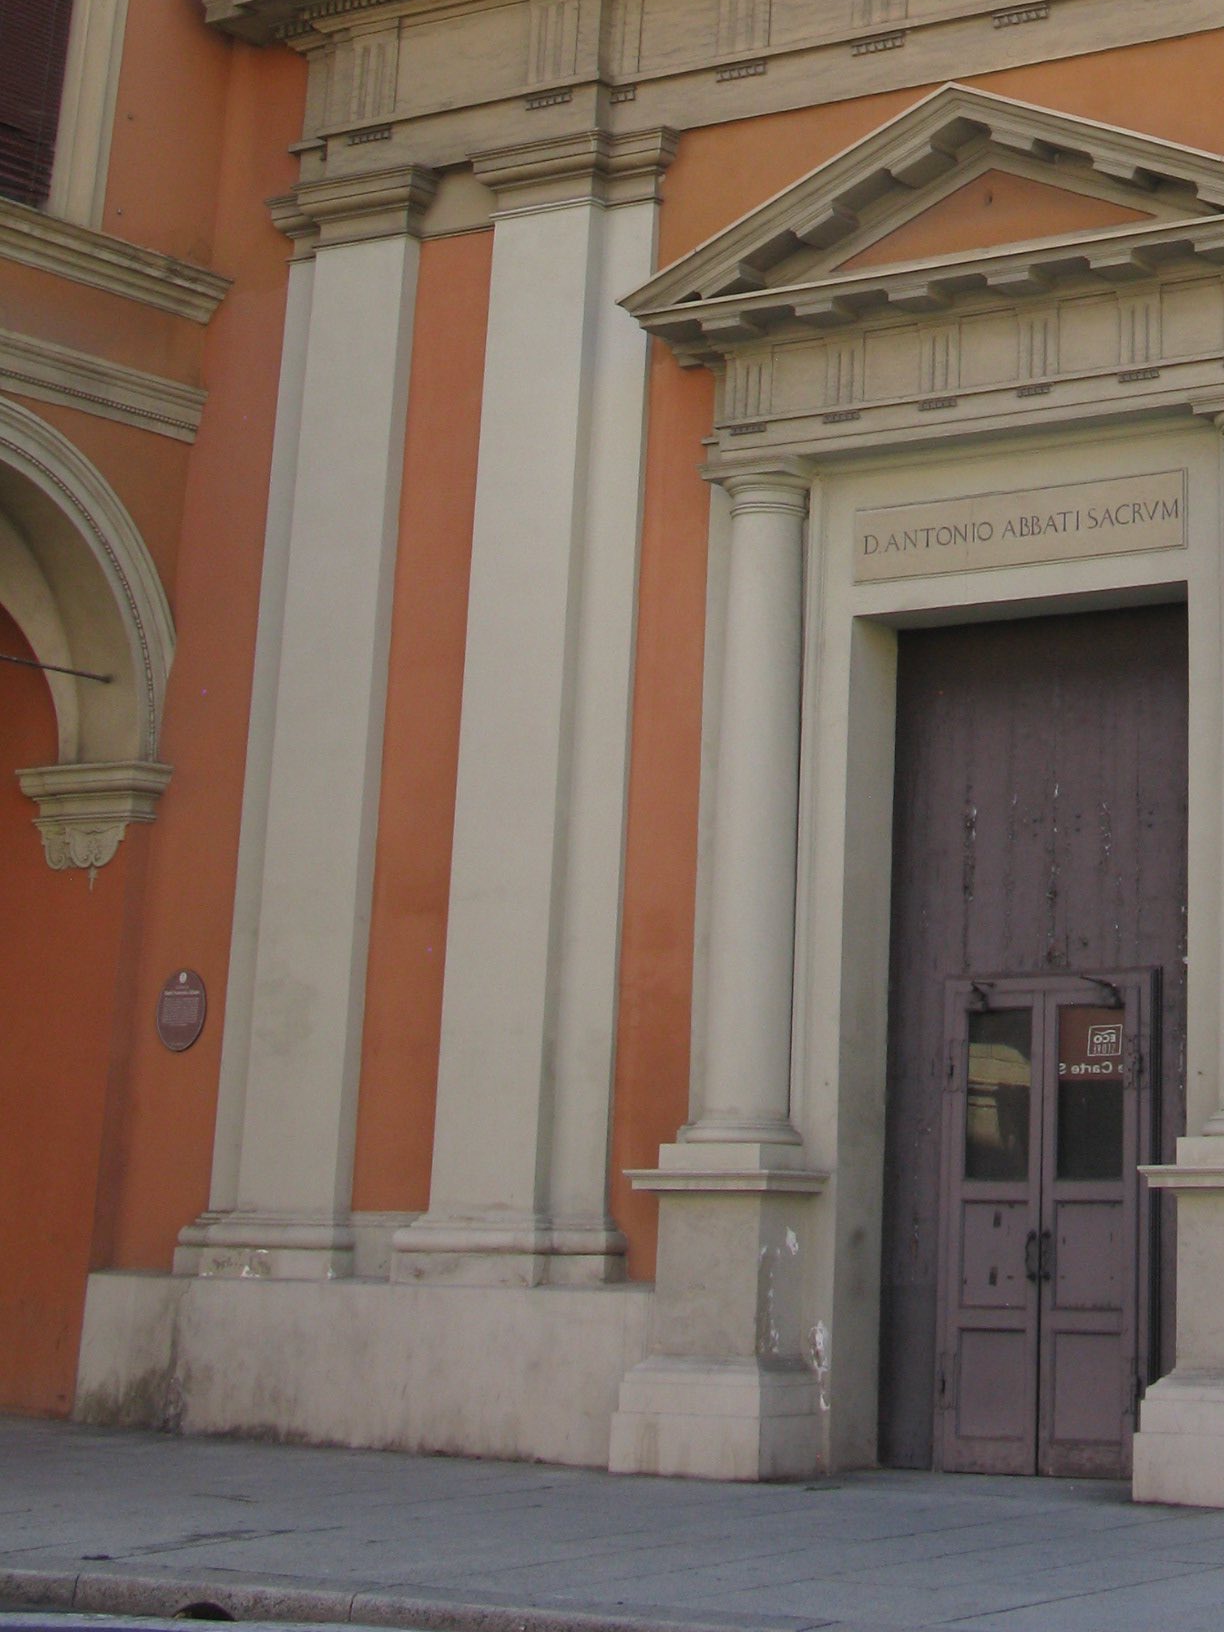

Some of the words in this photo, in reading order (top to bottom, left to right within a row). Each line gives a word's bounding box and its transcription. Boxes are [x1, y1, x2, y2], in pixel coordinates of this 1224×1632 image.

[884, 521, 994, 552] ANTONIO
[1001, 509, 1081, 540] ABBATI
[1087, 497, 1179, 530] SACRVM
